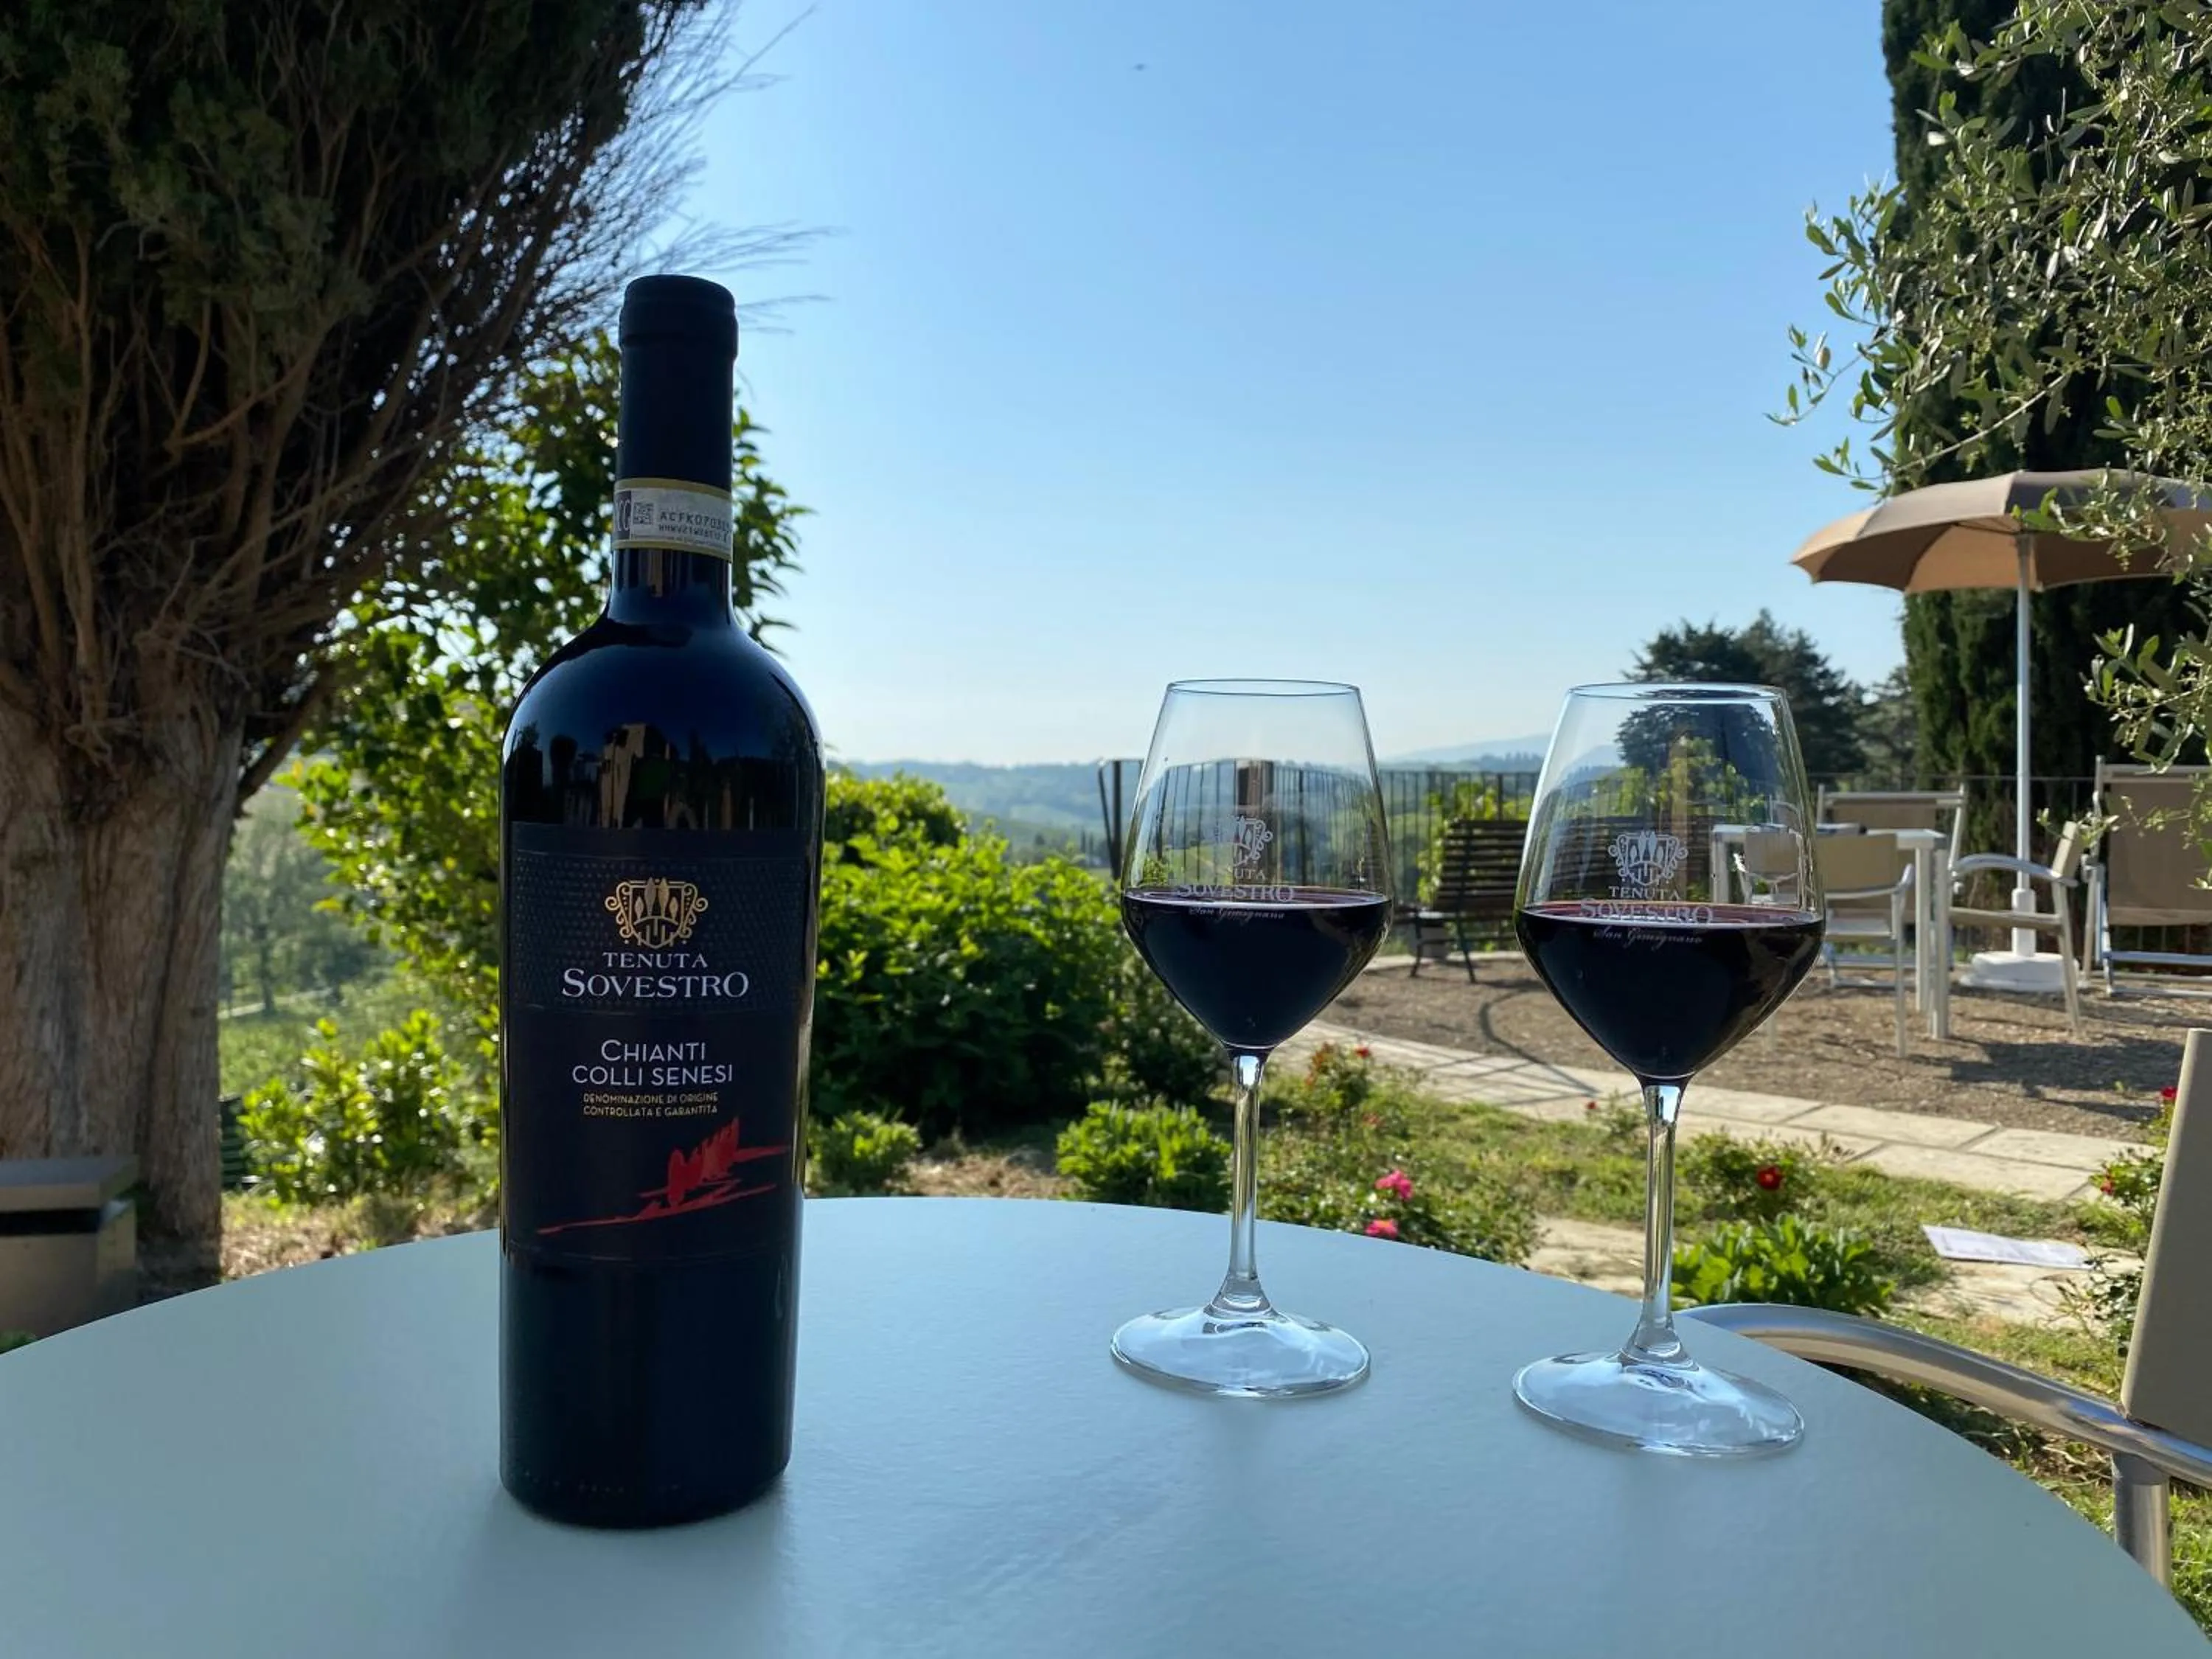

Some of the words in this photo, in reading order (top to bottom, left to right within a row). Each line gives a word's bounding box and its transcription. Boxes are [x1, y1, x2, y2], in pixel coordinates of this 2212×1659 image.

[1610, 886, 1681, 900] TENUTA
[1580, 898, 1714, 925] SOVESTRO
[1593, 925, 1622, 939] San
[602, 952, 709, 968] TENUTA
[562, 968, 749, 998] SOVESTRO
[601, 1040, 706, 1062] CHIANTI
[572, 1065, 643, 1086] COLLI
[650, 1064, 733, 1086] SENESI
[583, 1093, 664, 1105] DENOMINAZIONE
[667, 1093, 678, 1104] DI
[679, 1092, 718, 1104] ORIGINE
[583, 1105, 653, 1117] CONTROLLATA
[655, 1107, 661, 1117] E
[663, 1105, 718, 1116] GARANTITA
